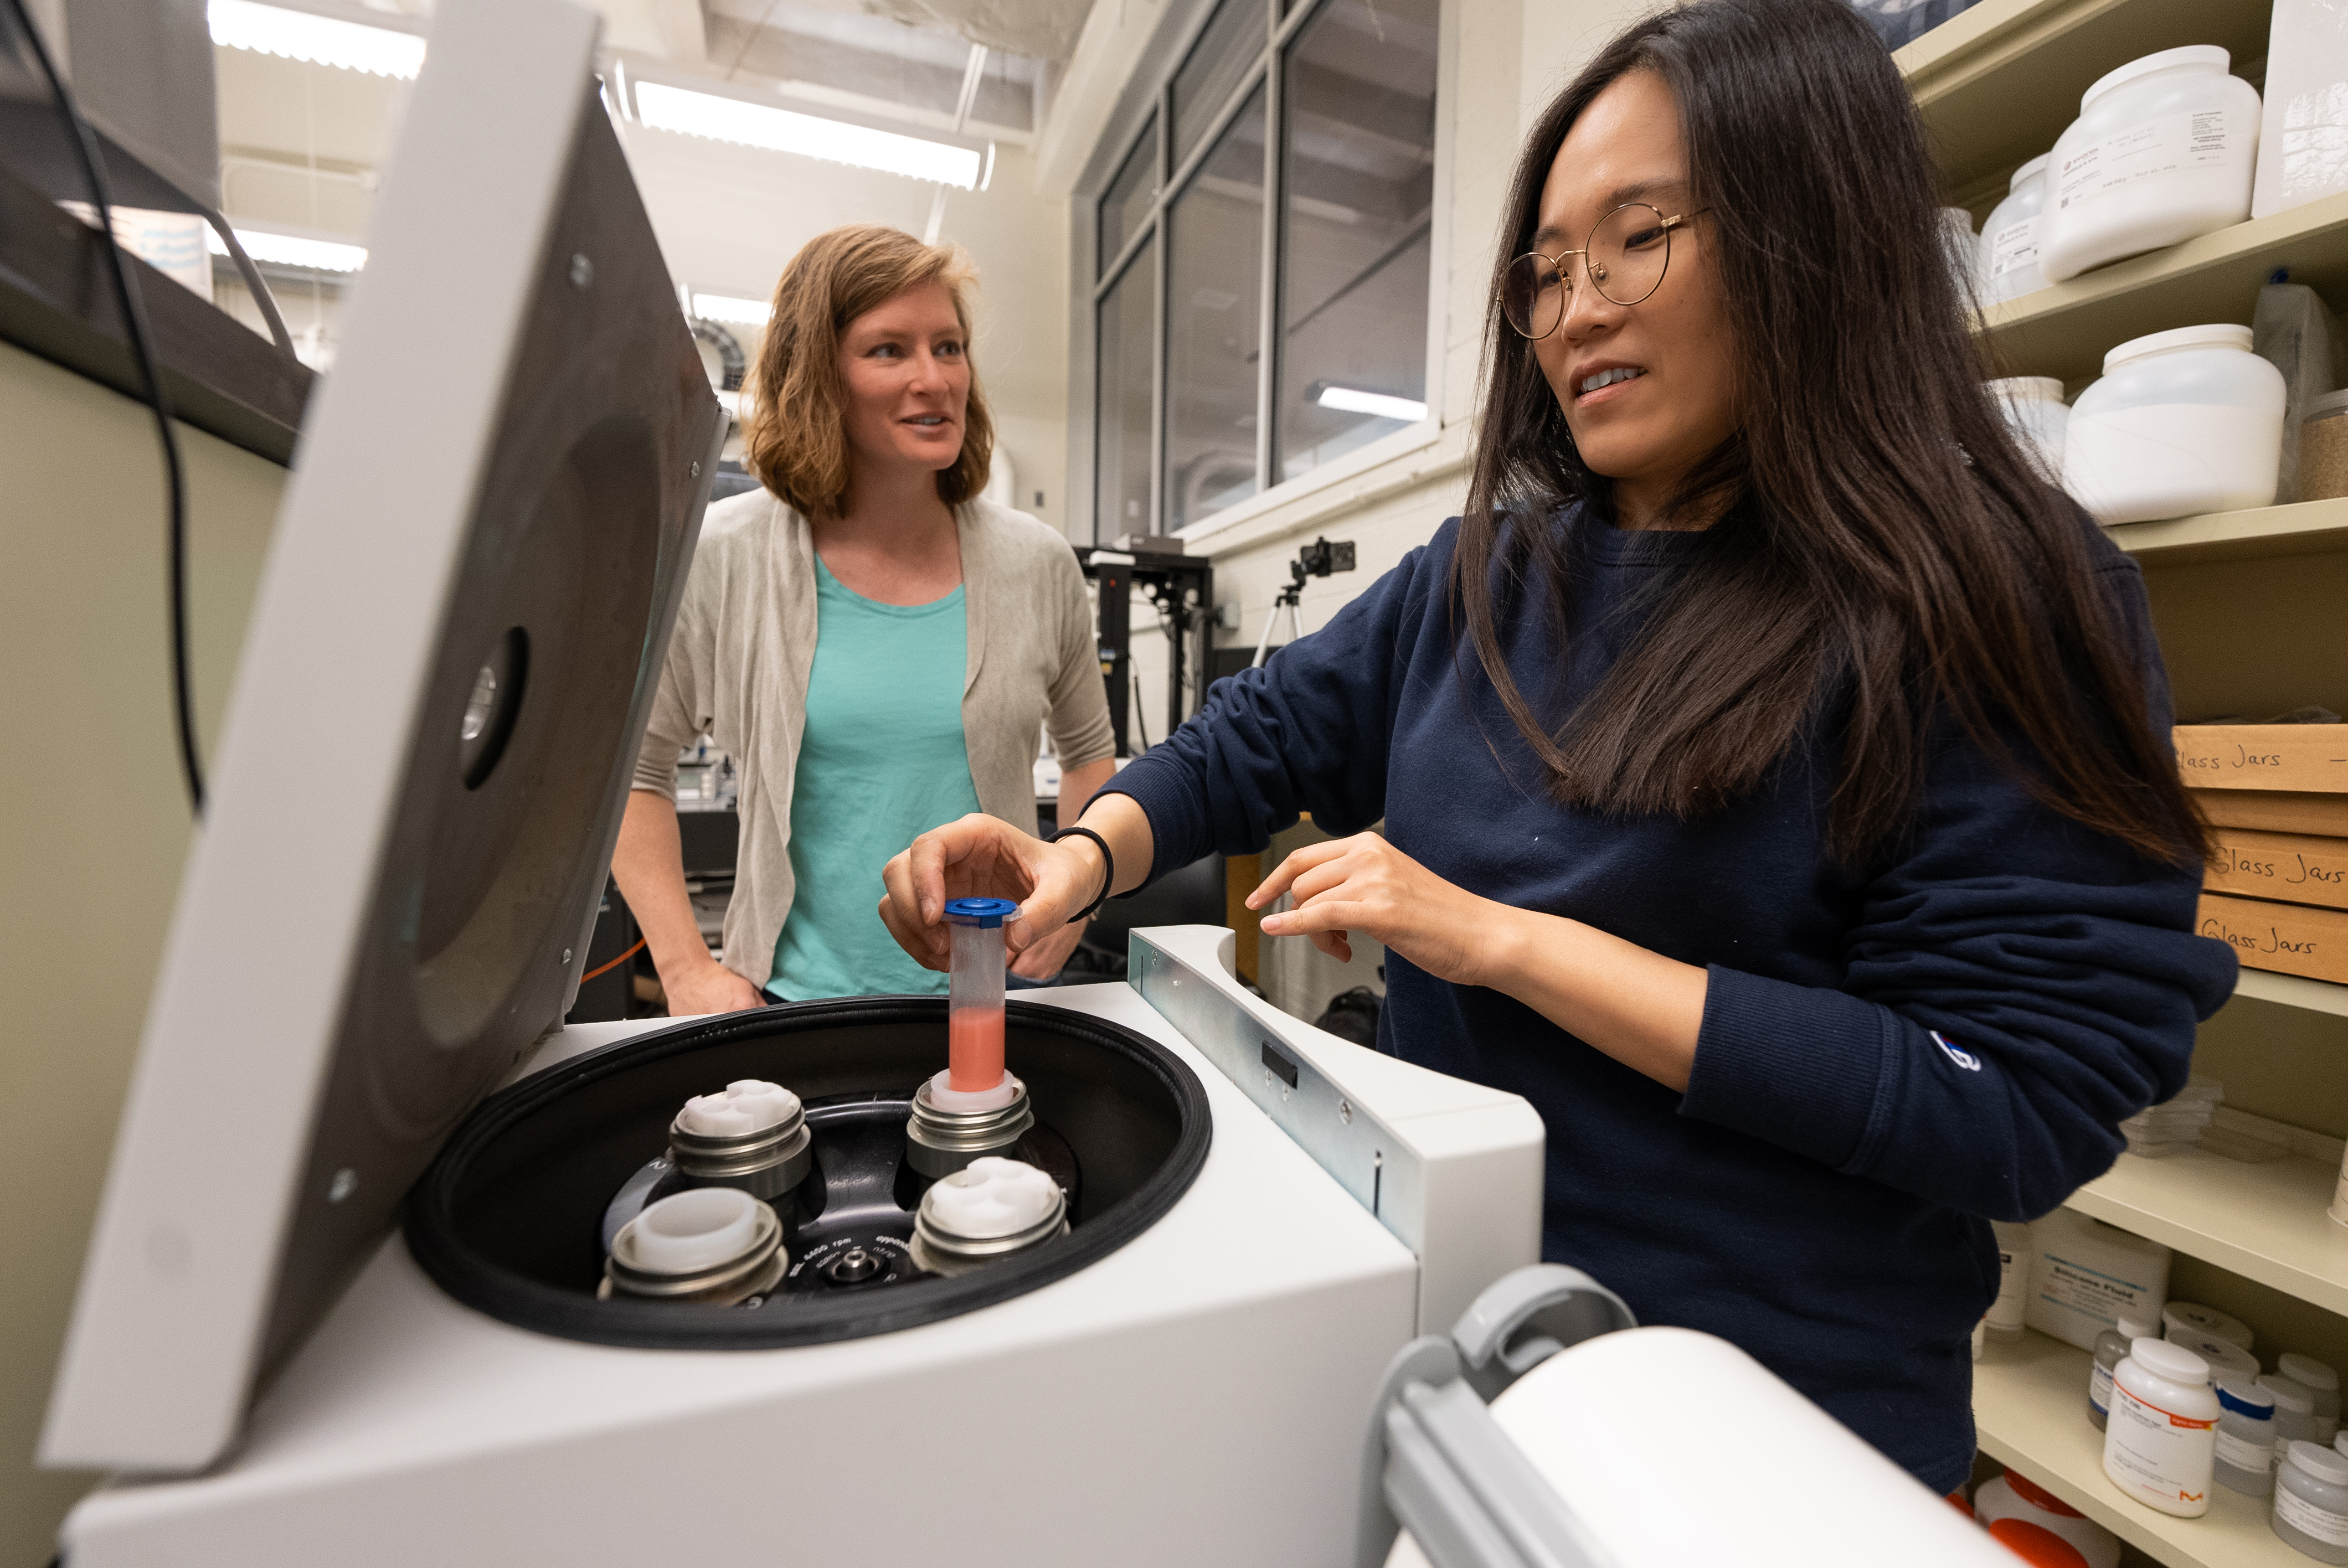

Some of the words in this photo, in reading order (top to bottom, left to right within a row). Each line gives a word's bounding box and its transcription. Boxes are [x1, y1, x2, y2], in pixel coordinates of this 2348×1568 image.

[2232, 744, 2280, 768] Jars
[2214, 846, 2274, 877] Glass
[2286, 854, 2346, 884] Jars
[2202, 919, 2257, 948] Glass
[2261, 927, 2317, 953] Jars
[832, 1238, 852, 1247] rpm
